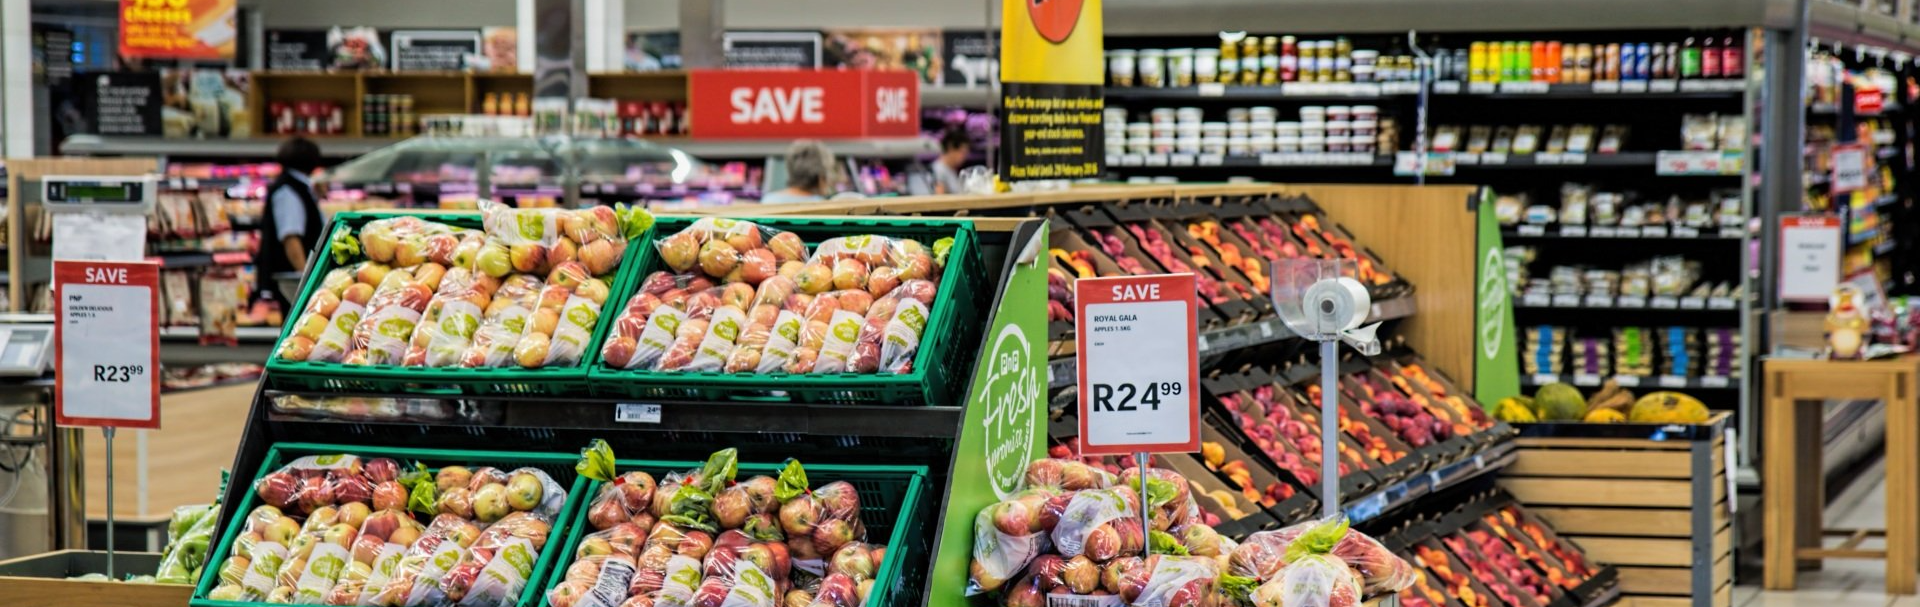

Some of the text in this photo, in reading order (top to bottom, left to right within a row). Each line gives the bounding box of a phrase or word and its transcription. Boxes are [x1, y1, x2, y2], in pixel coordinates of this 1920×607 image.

[730, 86, 825, 124] SAVE
[875, 87, 909, 123] SAVE
[85, 267, 128, 284] SAVE
[1112, 283, 1161, 301] SAVE
[1094, 314, 1138, 323] ROYAL GALA
[979, 341, 1041, 439] Fresh
[990, 428, 1023, 485] promise
